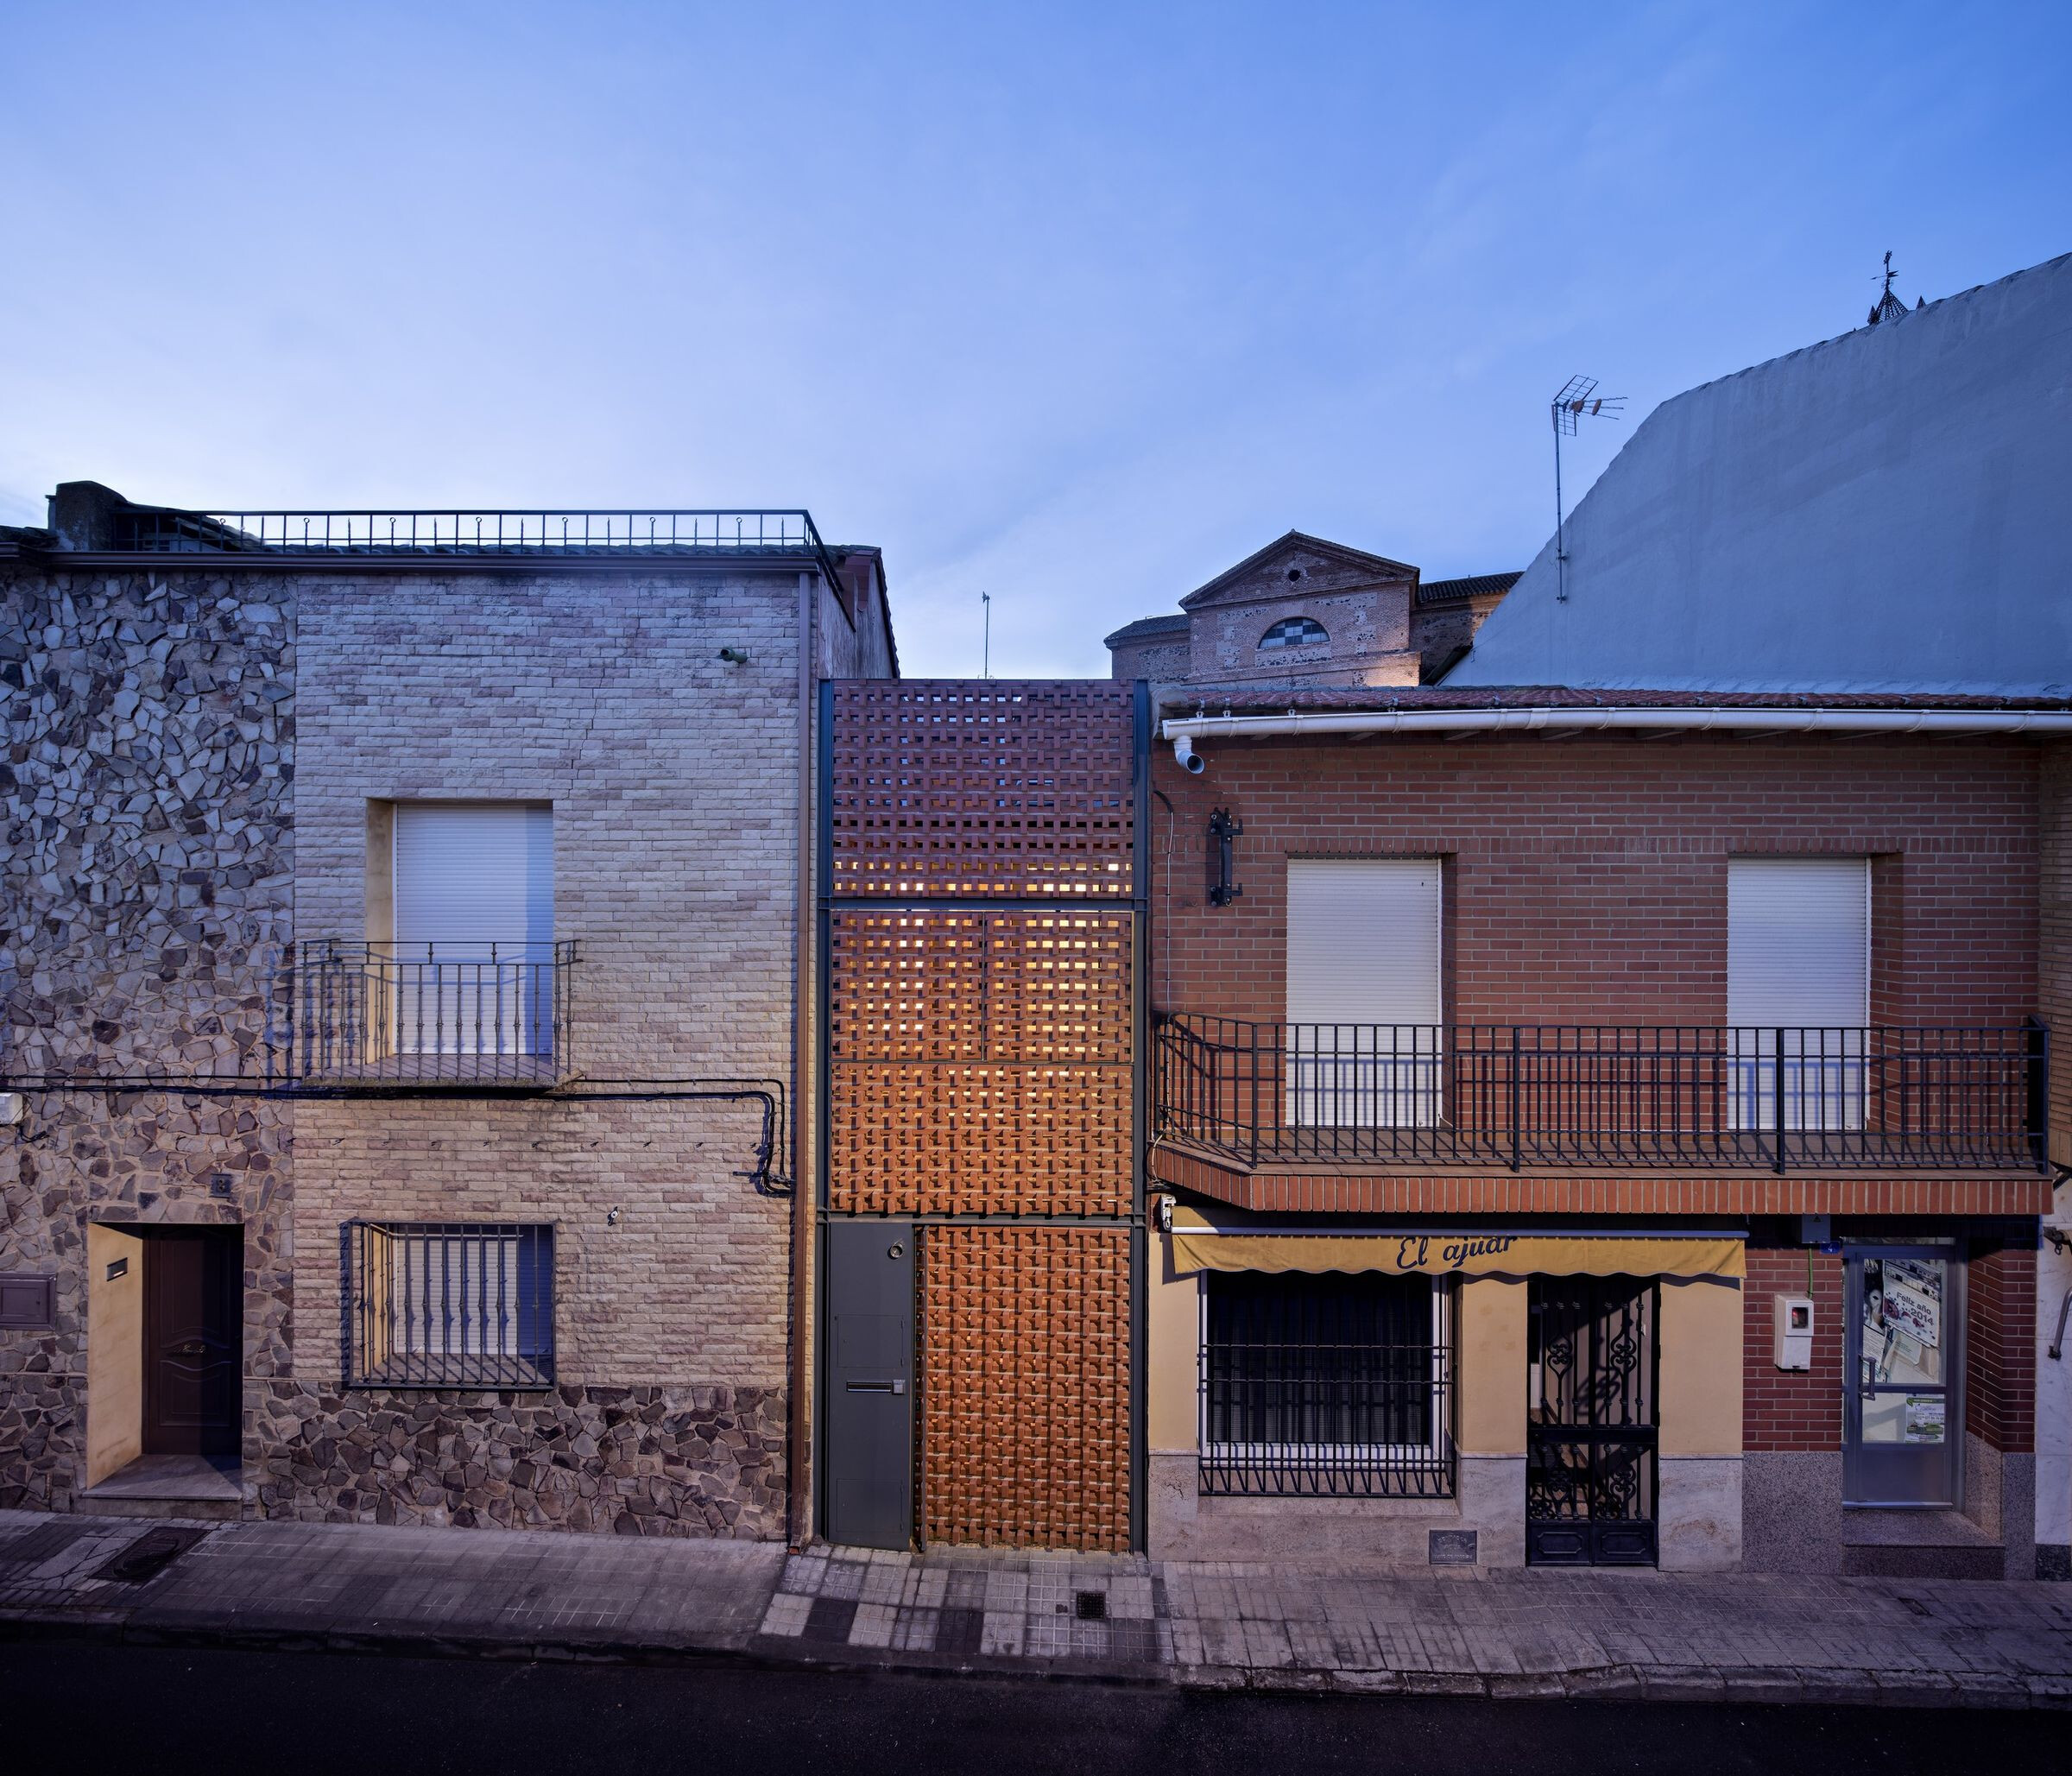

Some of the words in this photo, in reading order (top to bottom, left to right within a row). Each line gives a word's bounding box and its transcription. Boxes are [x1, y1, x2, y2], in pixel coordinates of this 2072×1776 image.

[1396, 1236, 1428, 1269] El
[1443, 1235, 1518, 1267] ajuar
[1897, 1292, 1915, 1306] Feliz
[1917, 1303, 1931, 1316] año
[1911, 1308, 1935, 1325] 2014
